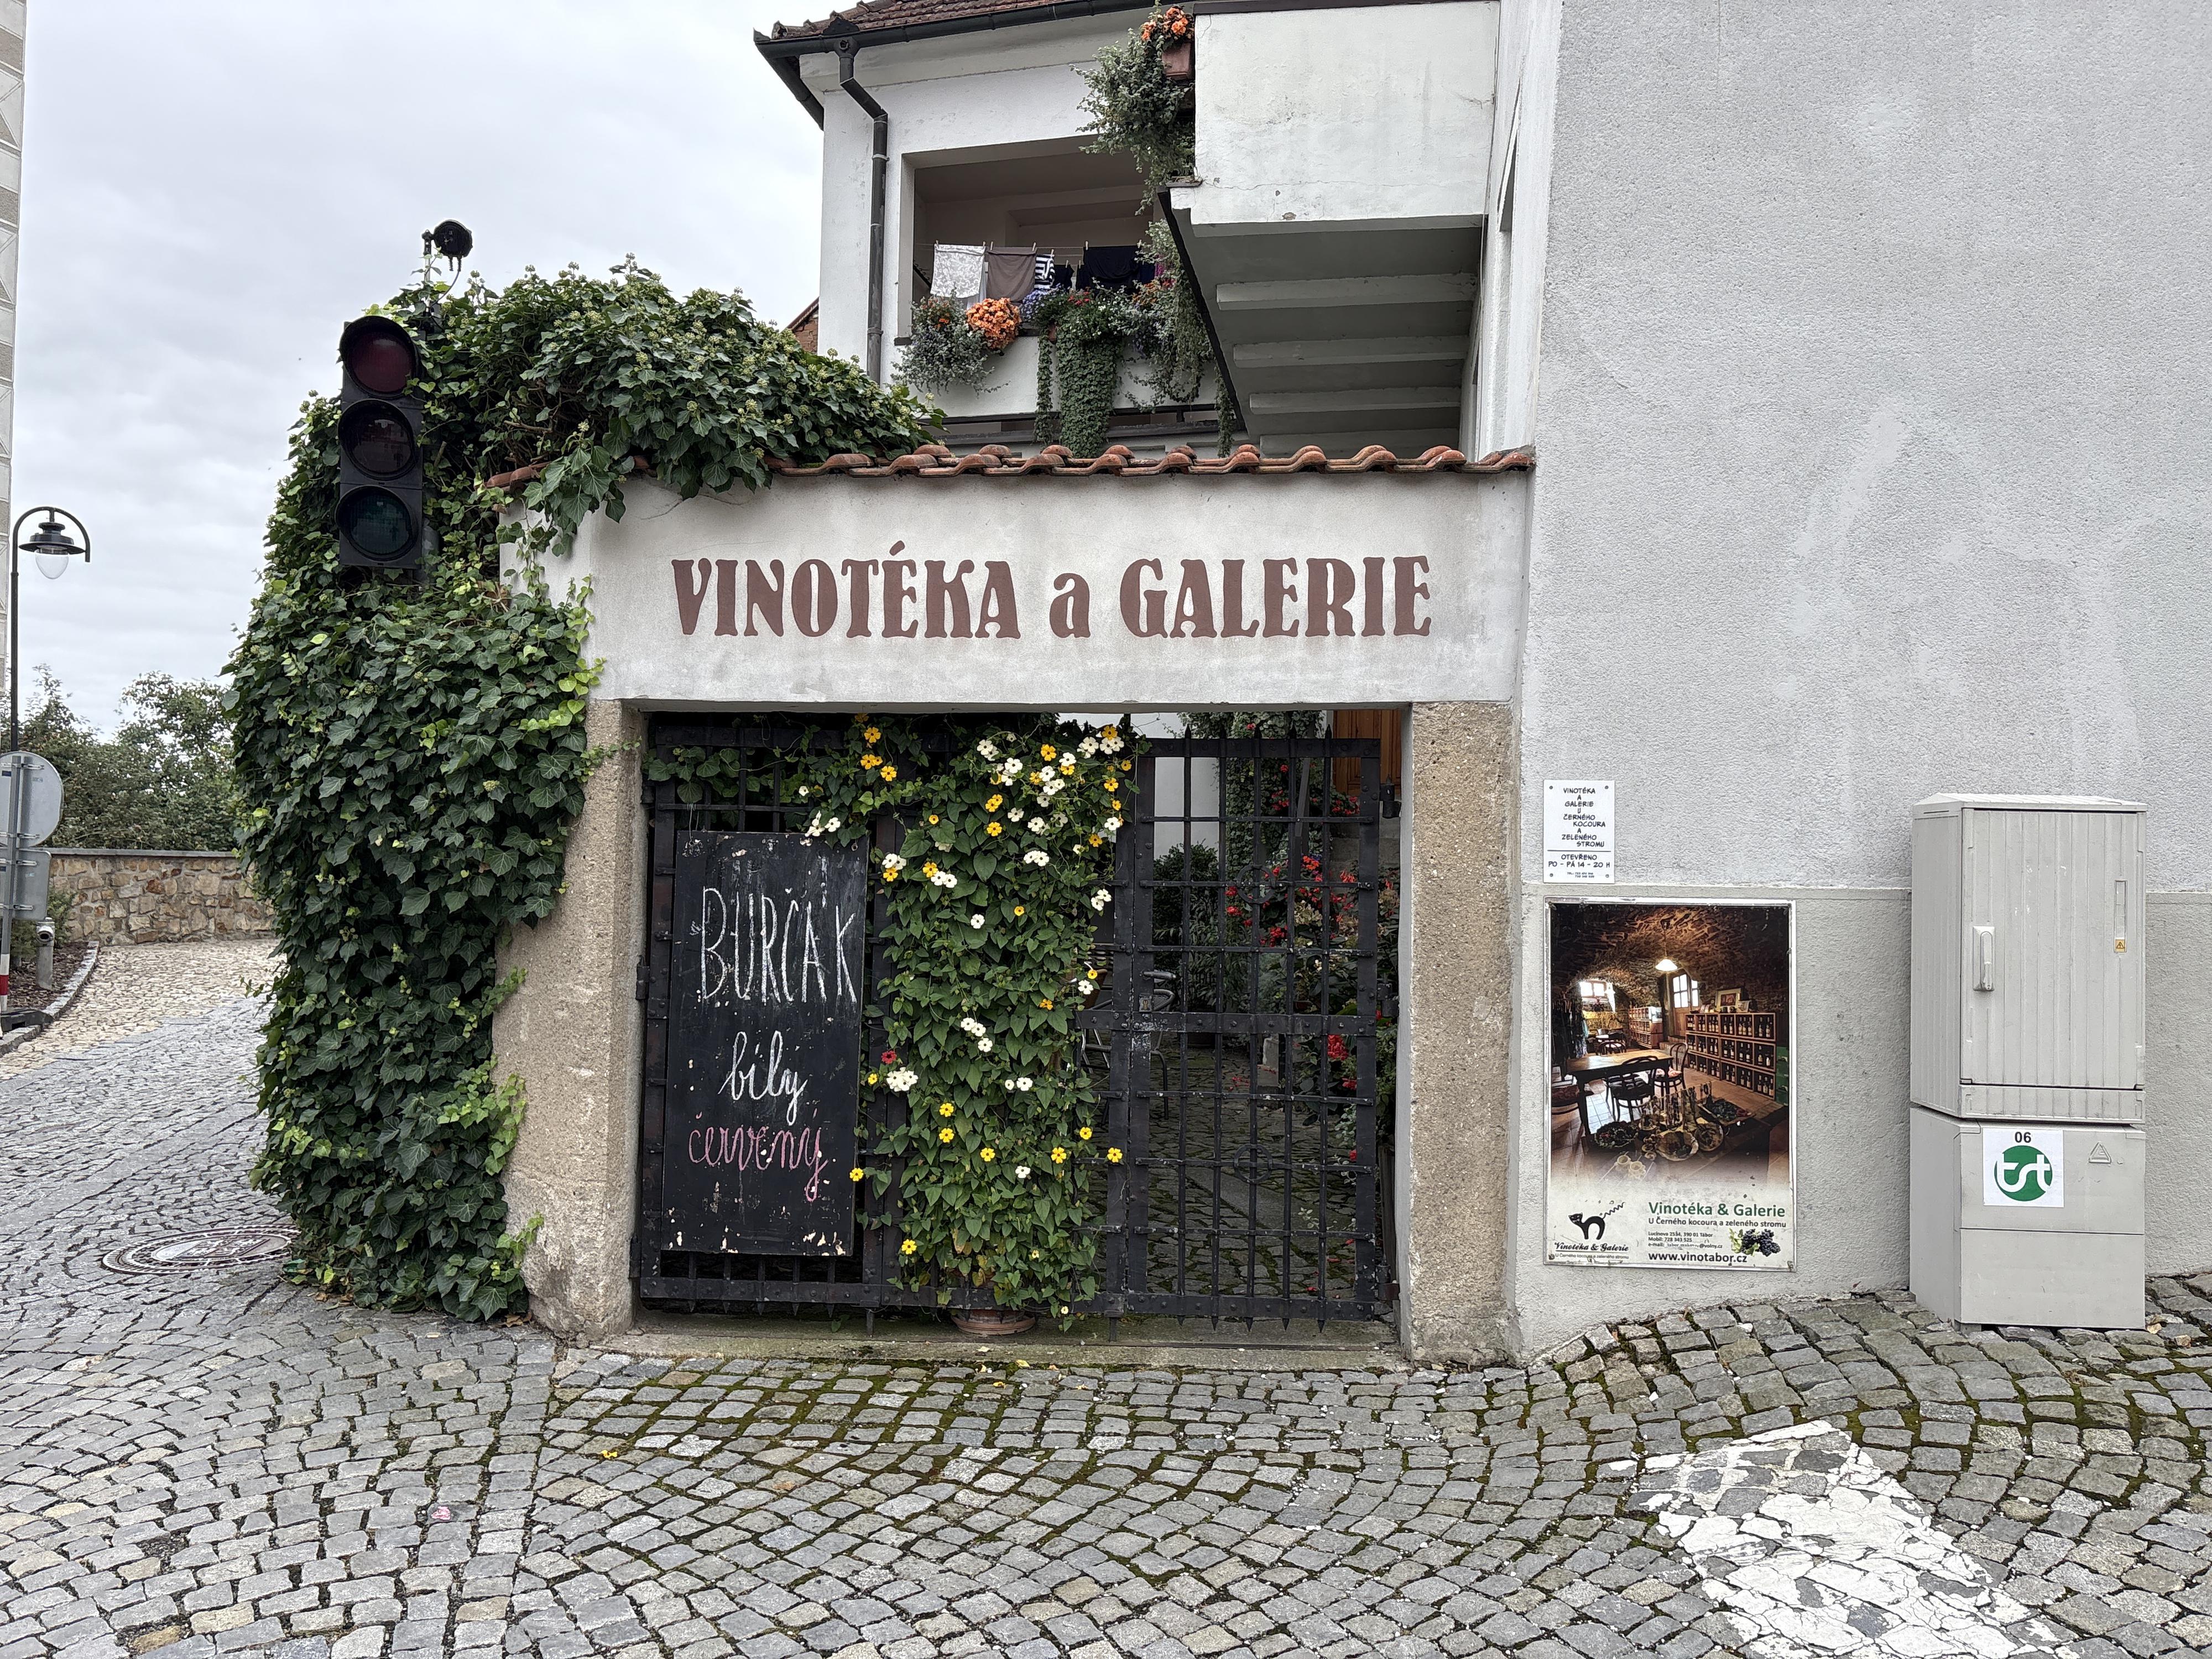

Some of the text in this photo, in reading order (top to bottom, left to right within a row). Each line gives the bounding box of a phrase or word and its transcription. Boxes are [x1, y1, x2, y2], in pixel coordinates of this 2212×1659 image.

[671, 540, 1432, 639] VINOTÉKA a GALERIE
[2015, 1131, 2032, 1143] 06
[1648, 1201, 1785, 1217] Vinotéka & Galerie
[1656, 1216, 1686, 1225] Černého
[1600, 1243, 1629, 1251] Galerie
[1648, 1251, 1747, 1262] www.vinotabor.cz
